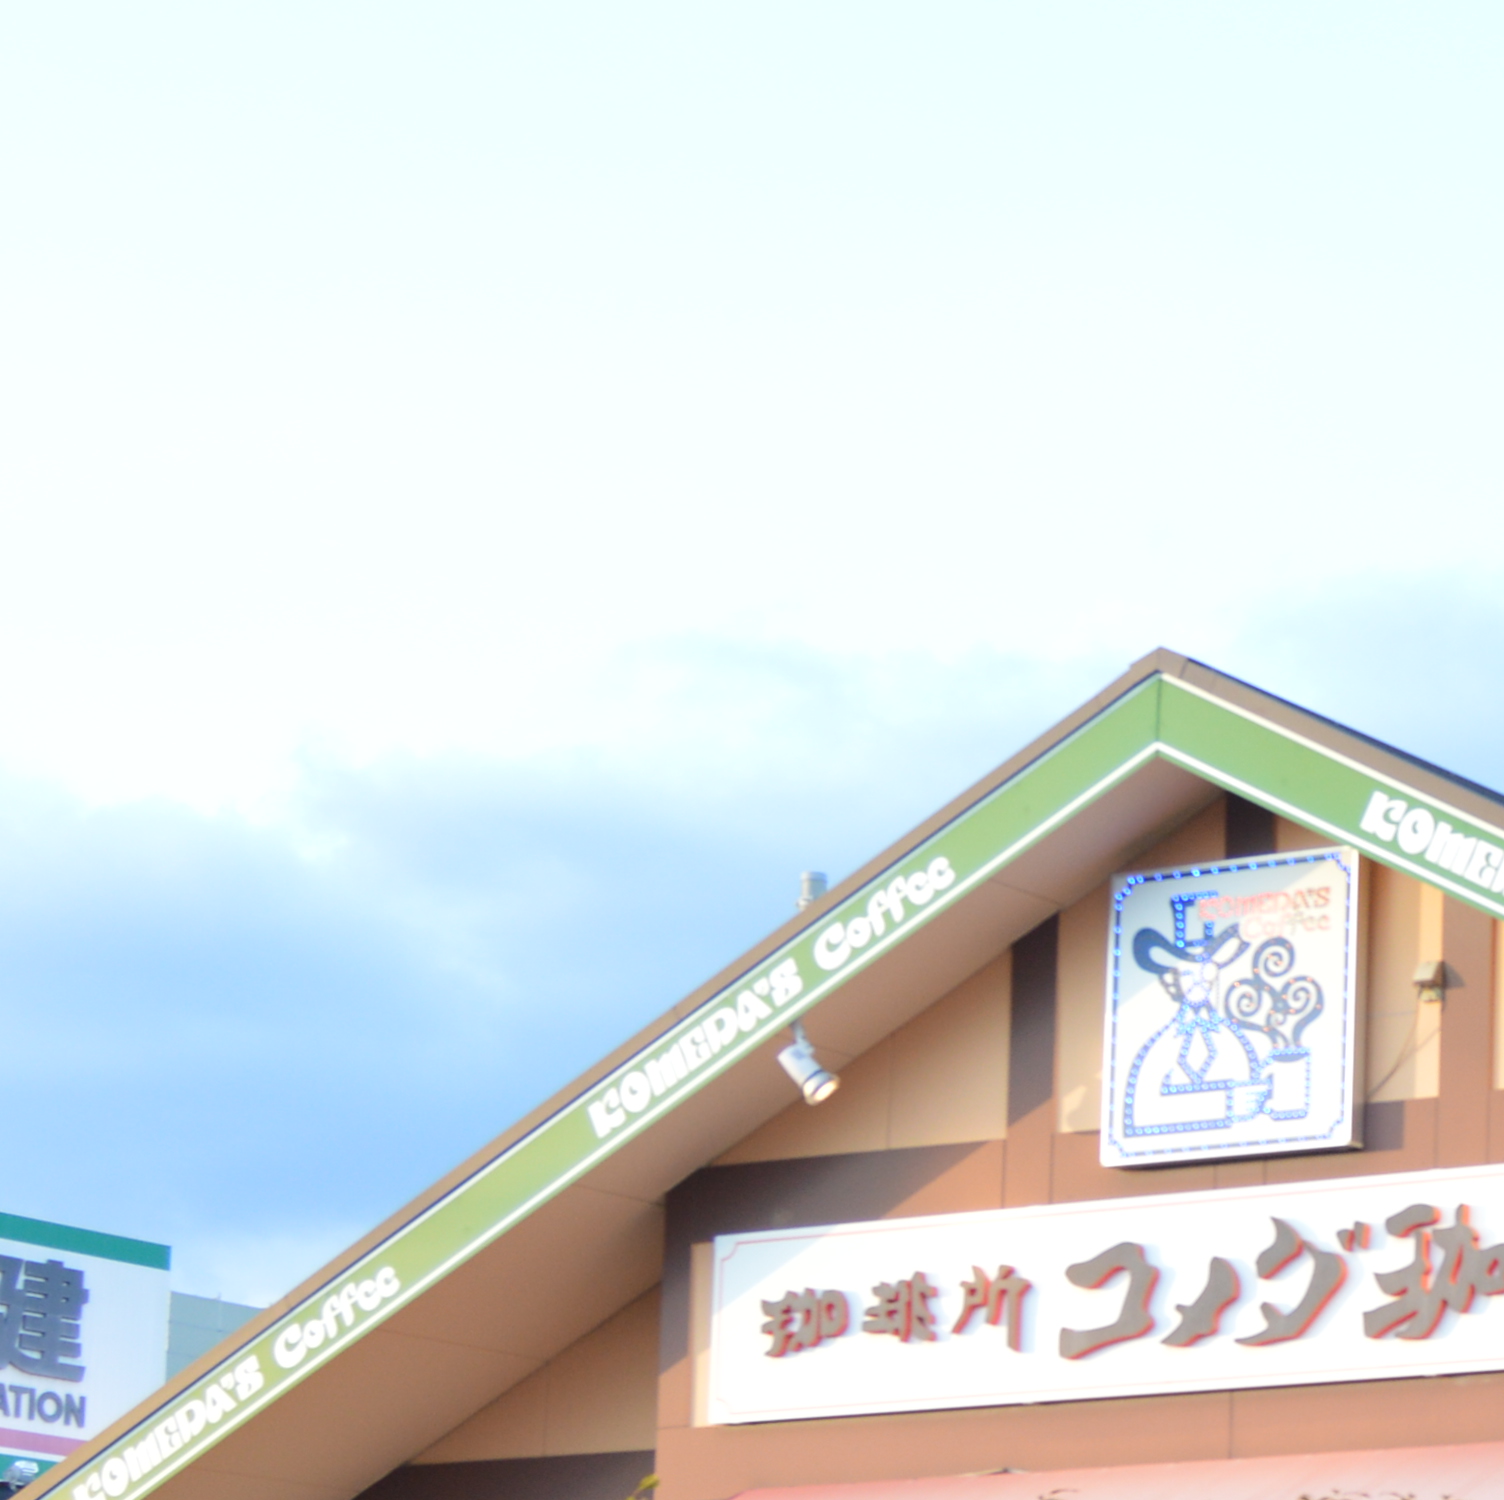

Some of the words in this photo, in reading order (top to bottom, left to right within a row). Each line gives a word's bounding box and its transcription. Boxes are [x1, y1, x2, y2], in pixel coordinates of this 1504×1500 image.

[587, 957, 803, 1139] KOMEDA'S
[813, 856, 956, 971] Coffee
[273, 1266, 400, 1369] Coffee
